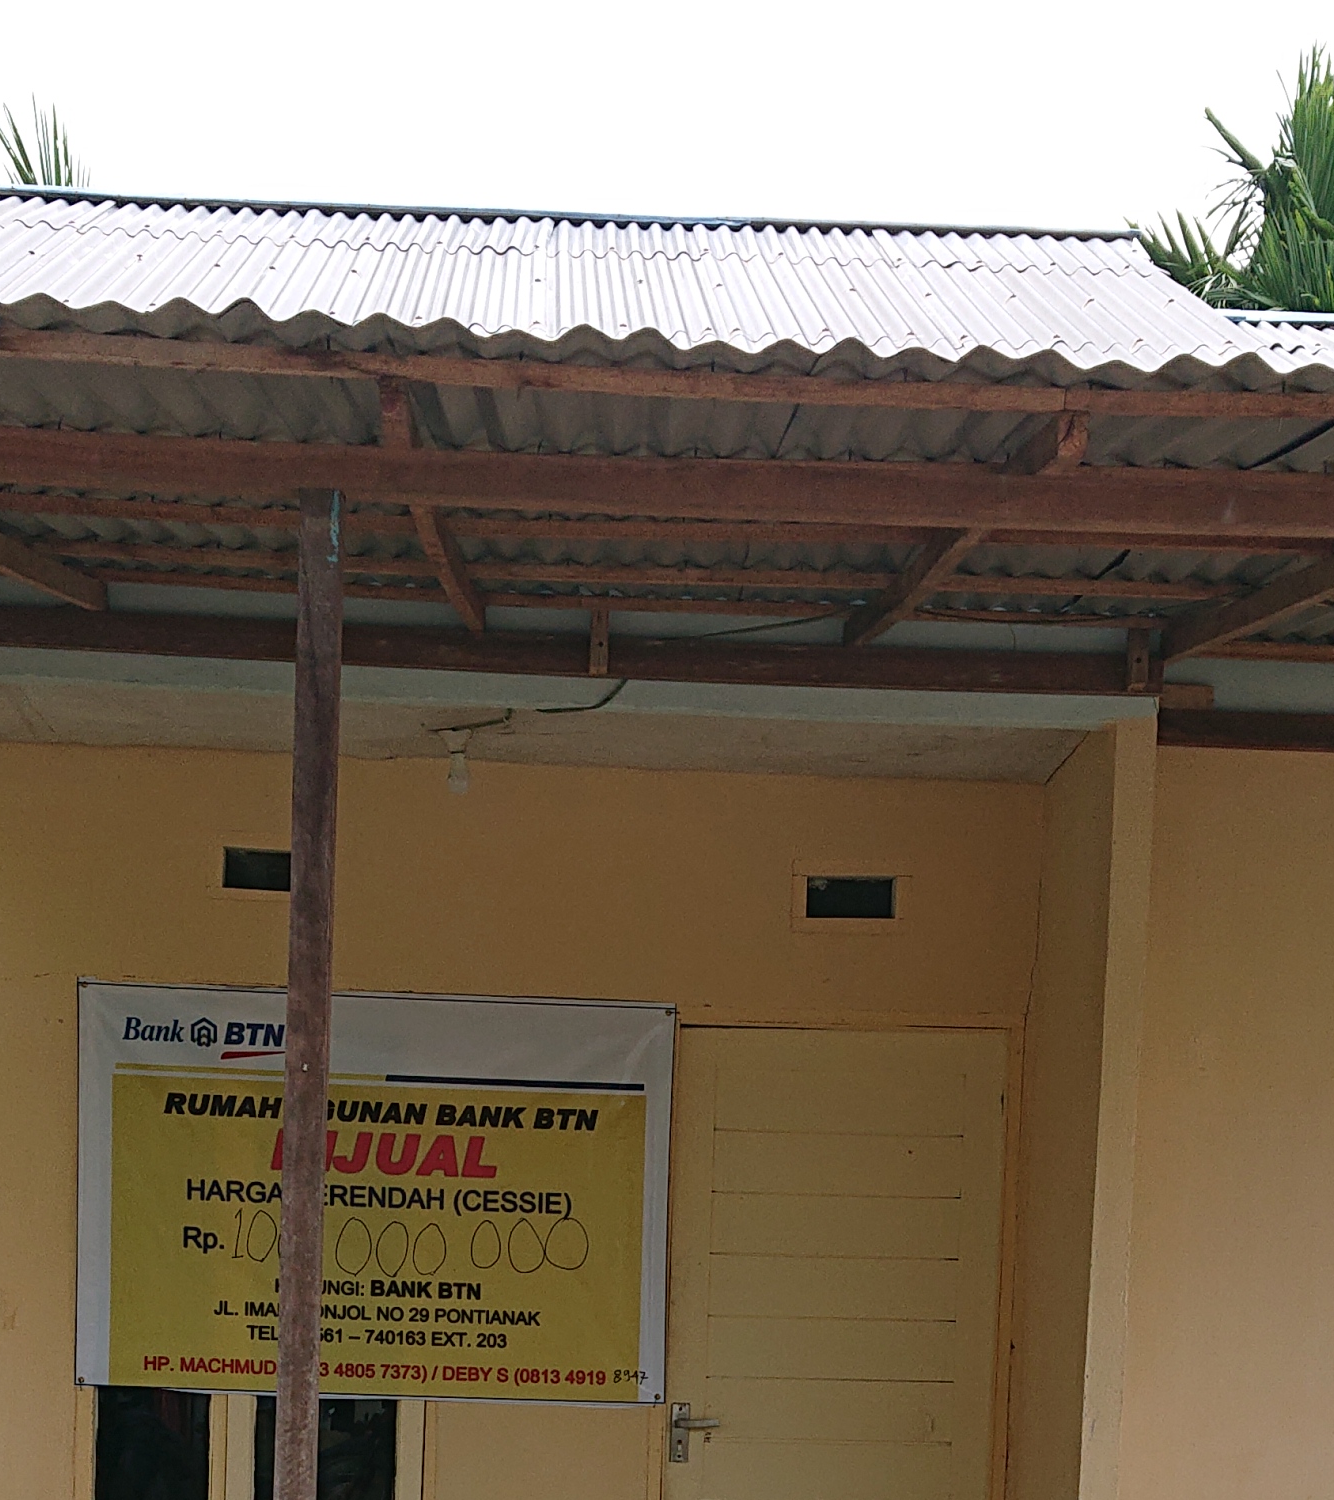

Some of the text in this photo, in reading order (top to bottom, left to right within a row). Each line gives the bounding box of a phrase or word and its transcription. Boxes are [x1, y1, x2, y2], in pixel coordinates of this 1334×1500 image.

[122, 1016, 286, 1047] Bank BTN
[164, 1092, 283, 1119] RUMAH
[435, 1104, 527, 1129] BANK
[533, 1108, 599, 1131] BTN
[186, 1178, 572, 1217] HARGA RENDAH (CESSIE)
[182, 1226, 225, 1254] Rp.
[370, 1280, 433, 1299] BANK
[438, 1282, 481, 1300] BTN
[213, 1300, 541, 1327] JL. IMA NJOL NO 29 PONTIANAK
[364, 1329, 426, 1346] 740163
[431, 1331, 472, 1347] EXT.
[476, 1333, 507, 1348] 203
[143, 1355, 174, 1372] HP.
[180, 1357, 277, 1376] MACHMUD
[333, 1362, 376, 1379] 4805
[380, 1364, 428, 1384] 7373)
[442, 1366, 493, 1383] DEBY
[496, 1367, 509, 1383] S
[514, 1367, 561, 1387] (0813
[564, 1369, 607, 1386] 4919
